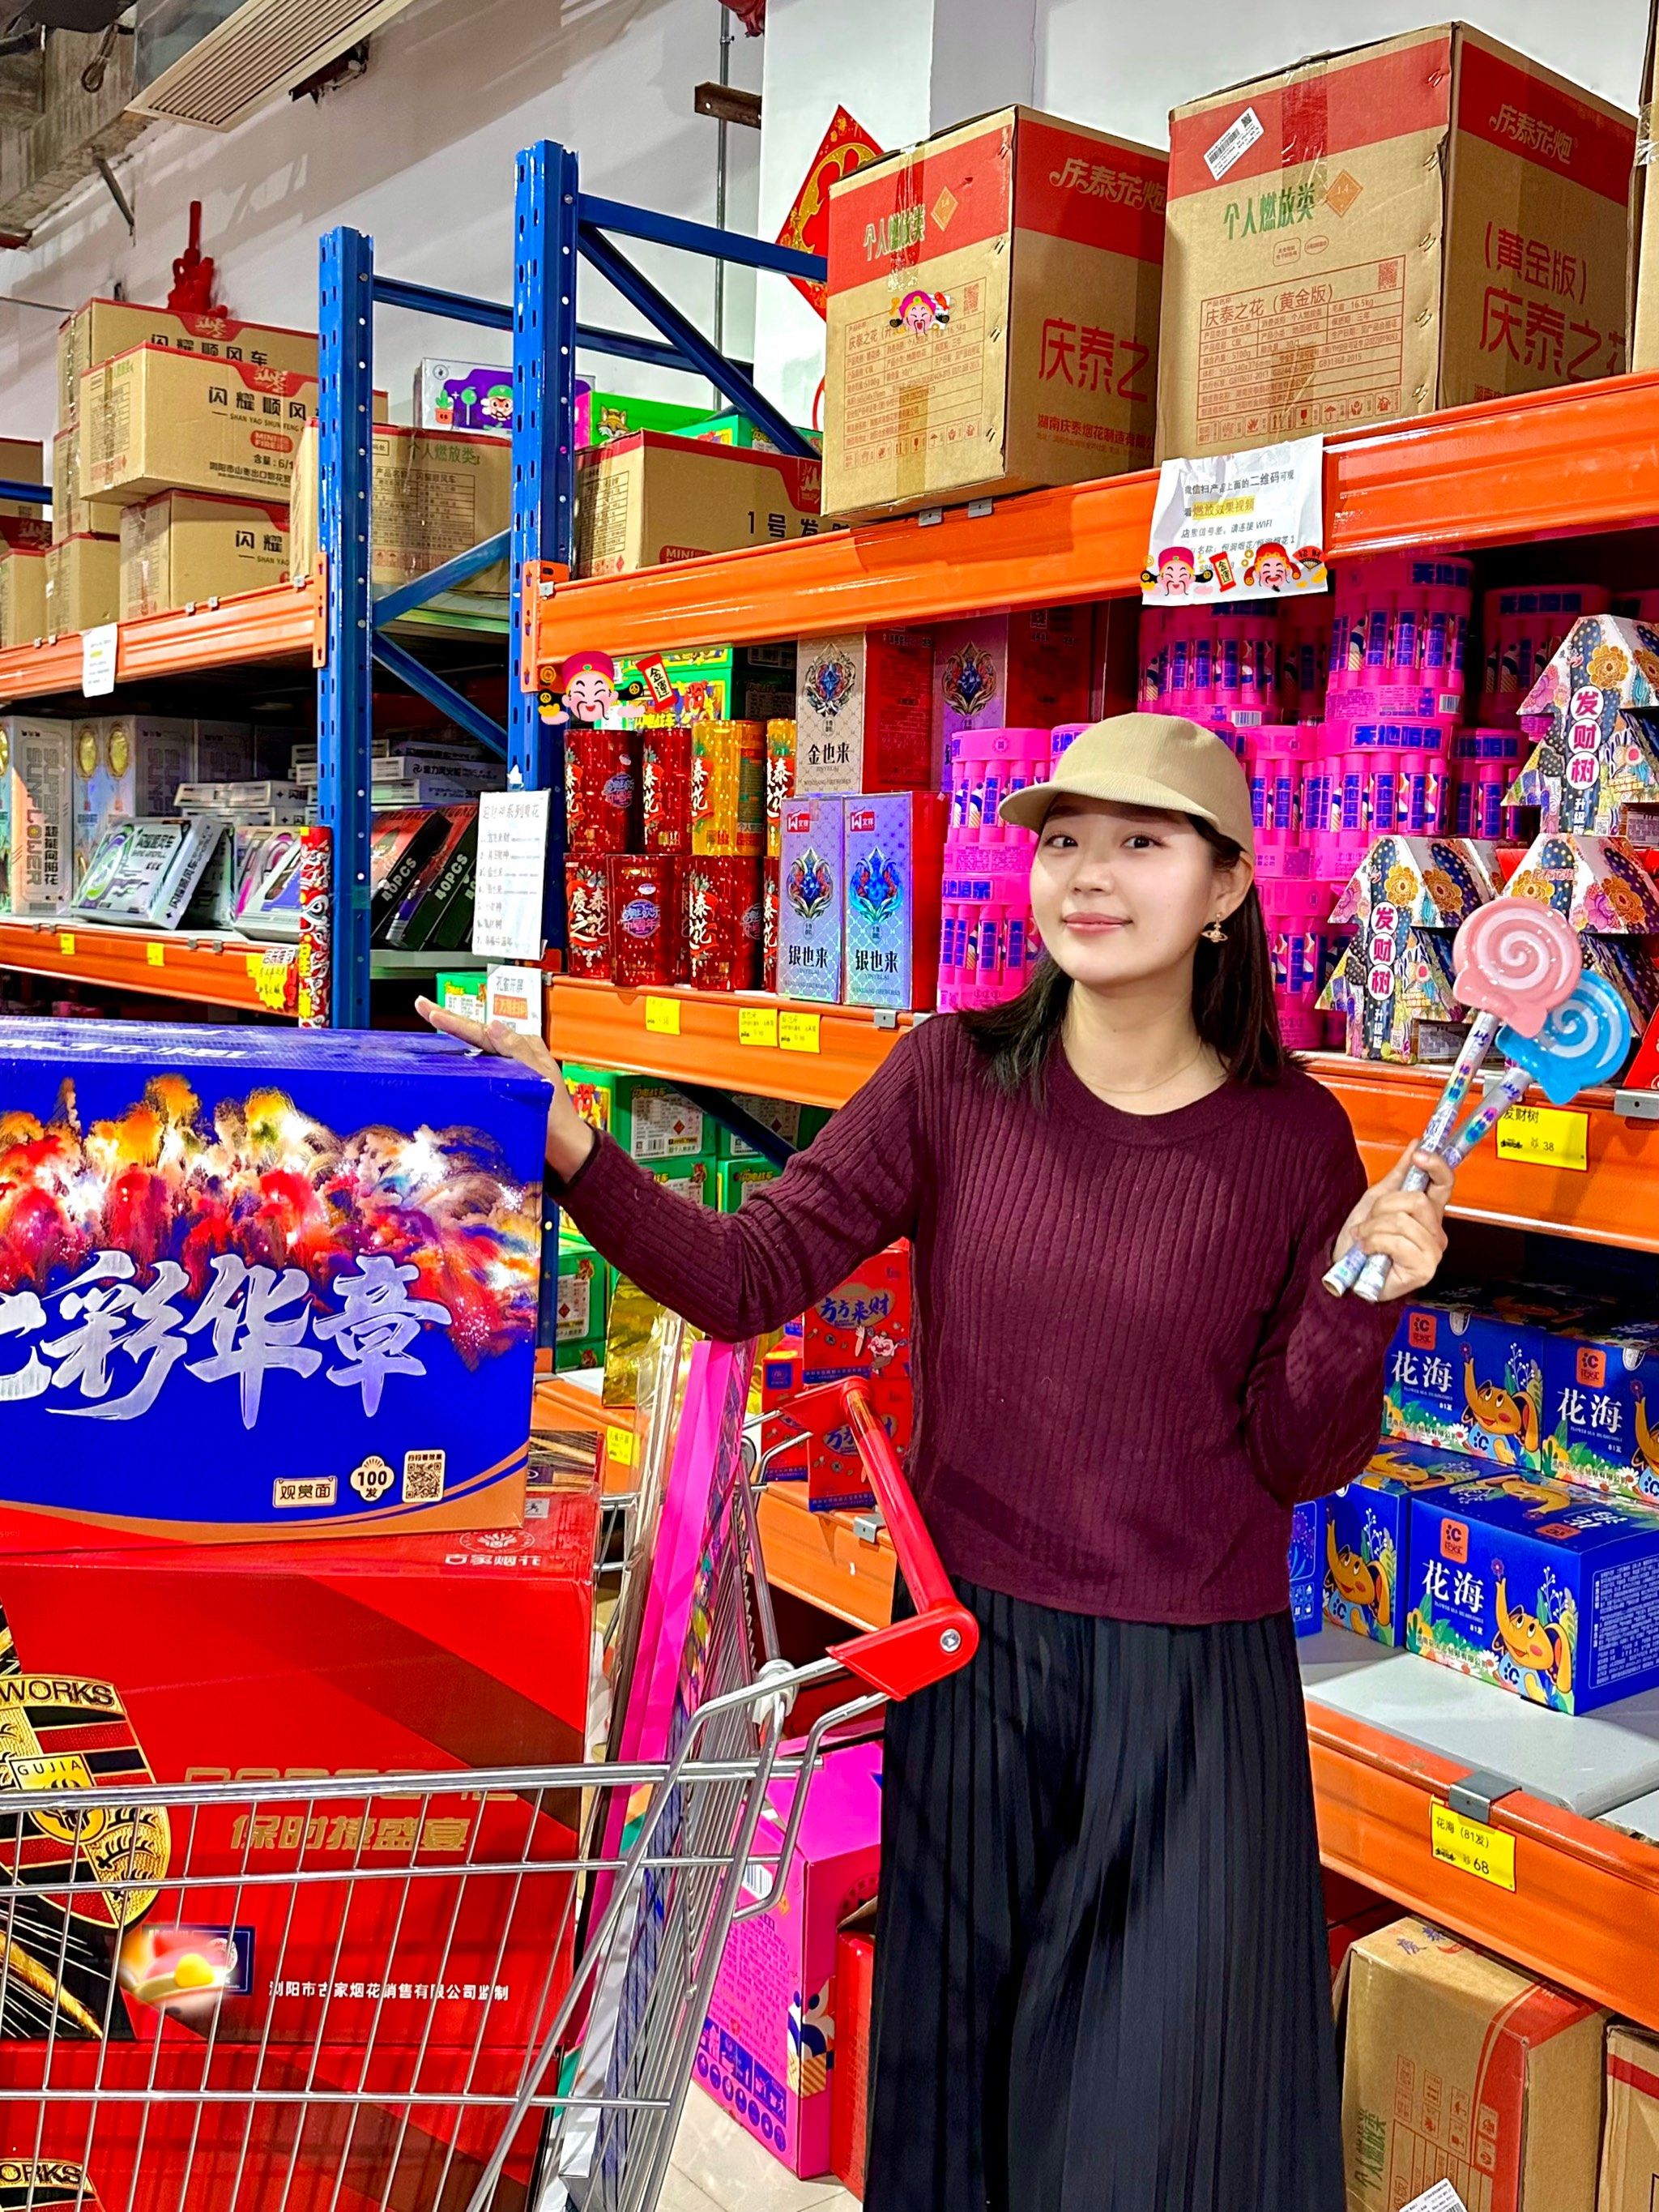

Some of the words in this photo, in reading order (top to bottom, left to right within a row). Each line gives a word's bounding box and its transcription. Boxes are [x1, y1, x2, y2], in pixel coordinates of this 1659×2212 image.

[1489, 103, 1575, 164] 庆泰花炮
[1223, 182, 1315, 240] 个人燃放类
[1038, 317, 1149, 403] 庆泰之
[209, 386, 319, 421] 闪耀顺风
[808, 742, 851, 765] 金也来
[1571, 691, 1598, 784] 发财树
[44, 825, 59, 886] 超能向阳花
[434, 853, 468, 900] 40PCS
[788, 944, 829, 969] 银也来
[855, 949, 899, 973] 银也来
[1371, 907, 1395, 995] 发财树
[1543, 1142, 1555, 1151] 38
[820, 1293, 890, 1325] 方方来财
[1391, 1350, 1453, 1392] 花海
[1557, 1387, 1623, 1433] 花海
[280, 1483, 331, 1501] 观赏面
[357, 1471, 387, 1486] 100
[365, 1488, 377, 1498] 发
[1422, 1558, 1485, 1614] 花海
[17, 1759, 83, 1776] GUJIA
[230, 1813, 471, 1852] 保时捷盛宴
[1473, 1857, 1490, 1875] 68
[268, 1979, 510, 2001] 浏阳市古家烟花销售有限公司监制
